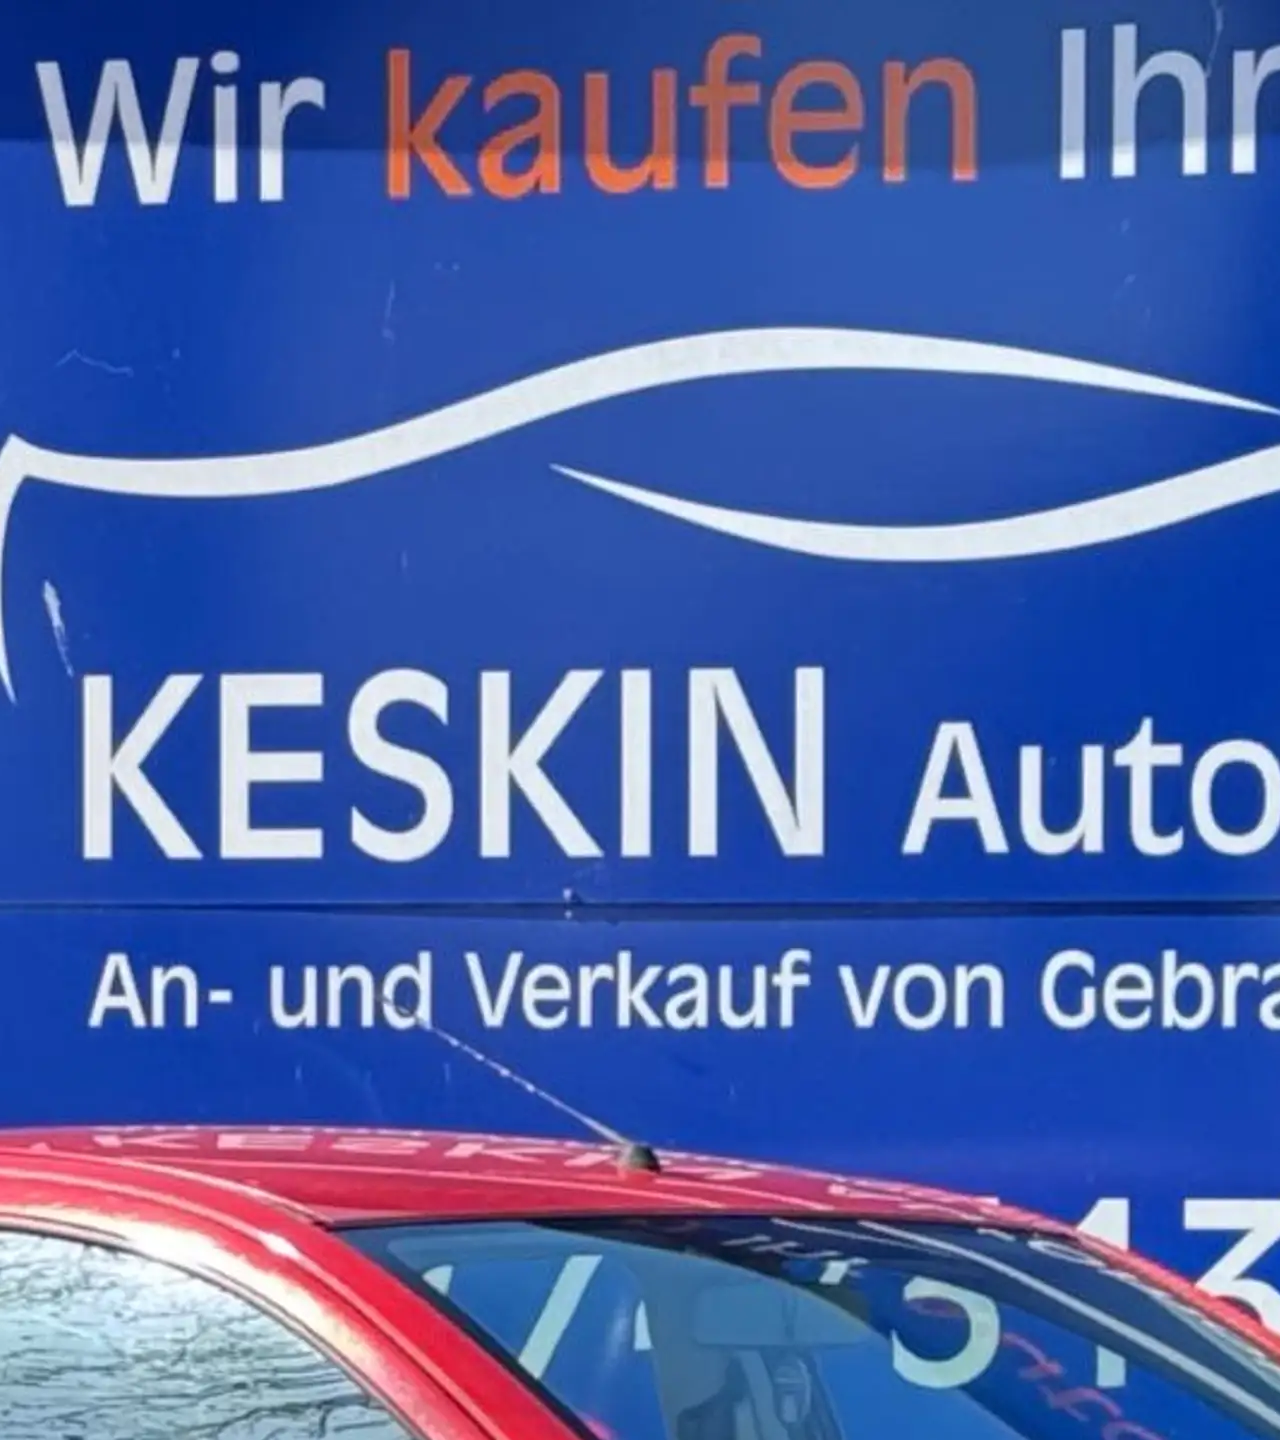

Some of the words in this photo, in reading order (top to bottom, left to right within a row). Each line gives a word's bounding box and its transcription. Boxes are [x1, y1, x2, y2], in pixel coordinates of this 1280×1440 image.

[35, 50, 326, 208] Wir
[385, 34, 978, 200] kaufen
[81, 666, 825, 862] KESKIN
[88, 952, 233, 1029] An-
[269, 950, 433, 1029] und
[465, 948, 812, 1030] Verkauf
[839, 963, 1005, 1030] von
